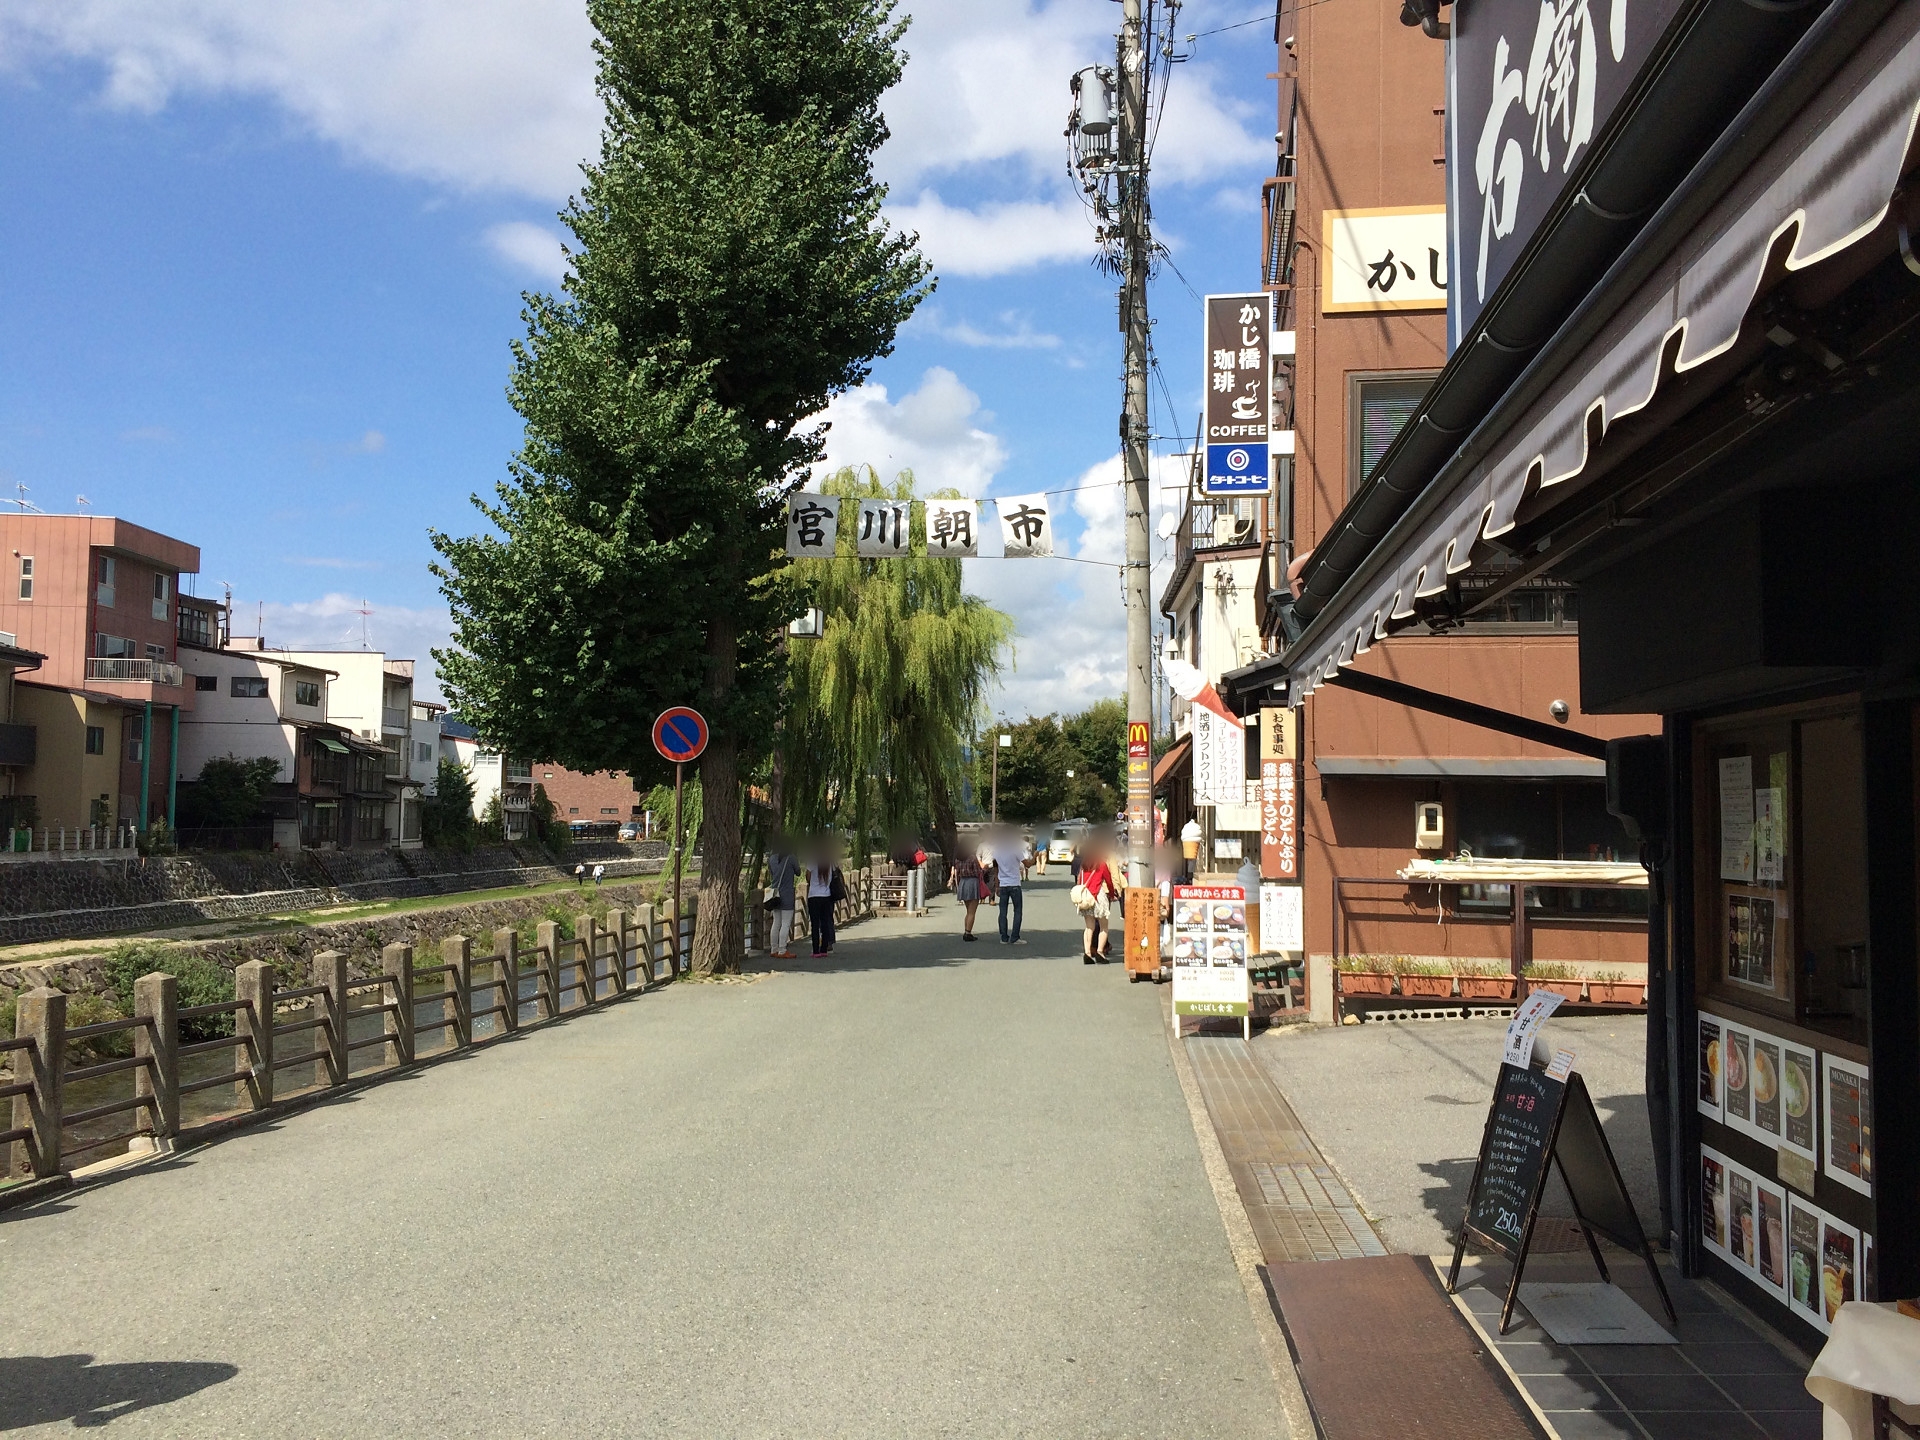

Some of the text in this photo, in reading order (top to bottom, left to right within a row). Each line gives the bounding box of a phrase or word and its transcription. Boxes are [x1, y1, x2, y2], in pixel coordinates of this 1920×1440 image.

[1238, 303, 1261, 370] かじ橋
[1213, 349, 1235, 393] 珈琲
[1210, 425, 1267, 437] COFFEE
[792, 501, 1047, 550] 宮川朝市
[1272, 712, 1284, 755] お食事処
[1199, 712, 1211, 800] 地酒ソフトクリーム
[1263, 762, 1278, 846] 飛騨牛うどん
[1278, 762, 1295, 873] 飛騨牛のどんぶり
[1180, 888, 1240, 899] 朝6時から営業
[1190, 1003, 1233, 1013] かじばし食堂
[1513, 1016, 1530, 1050] 甘酒
[1831, 1070, 1858, 1088] MONAKA
[1517, 1094, 1535, 1112] 甘酒
[1494, 1207, 1522, 1239] 250円
